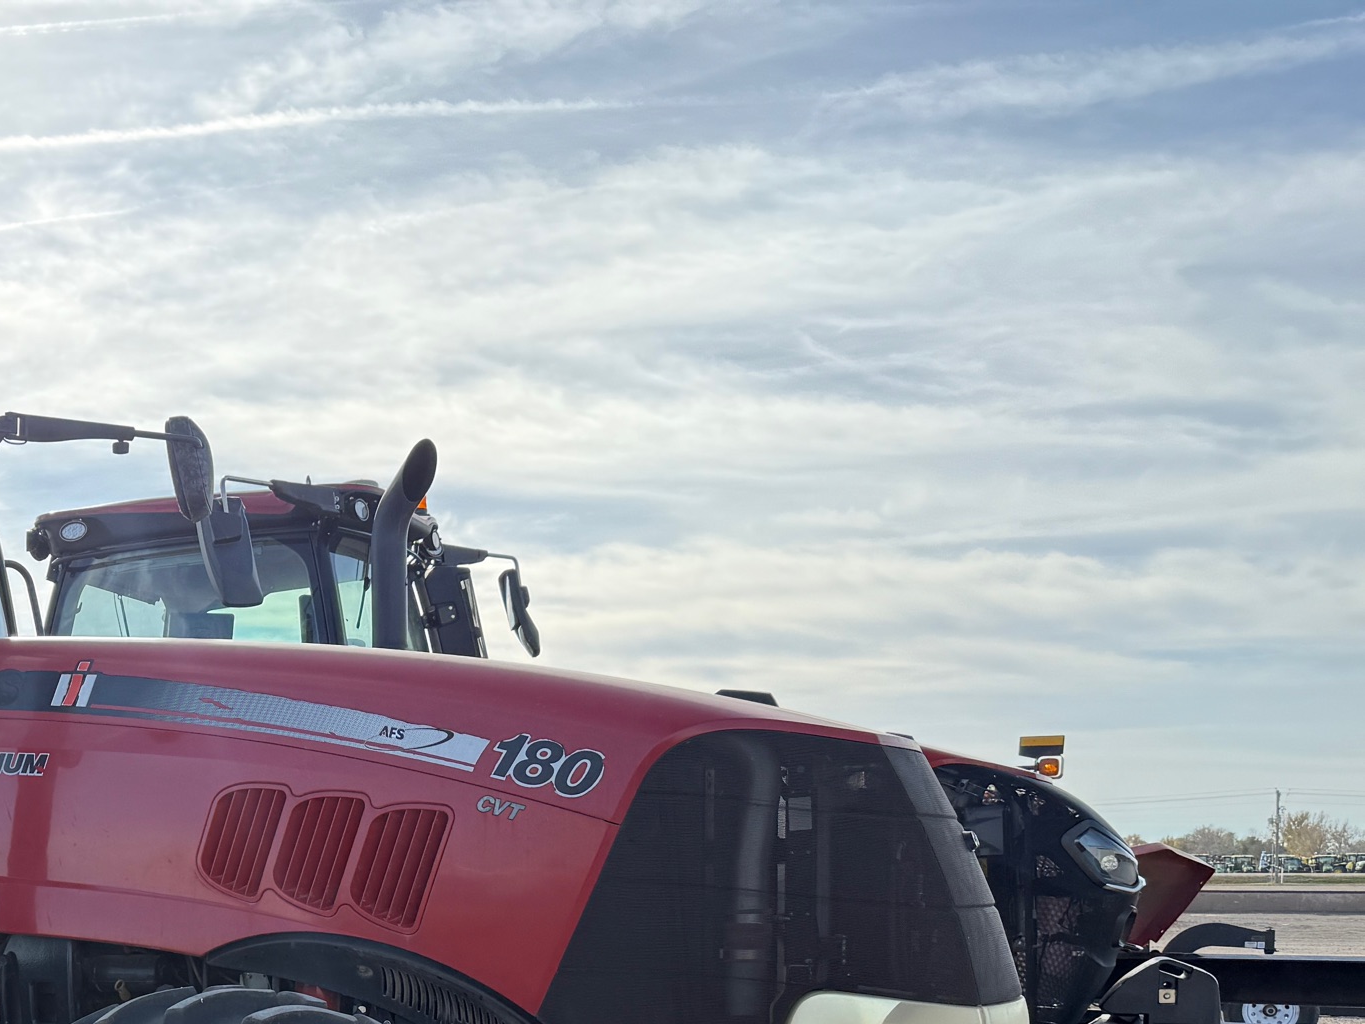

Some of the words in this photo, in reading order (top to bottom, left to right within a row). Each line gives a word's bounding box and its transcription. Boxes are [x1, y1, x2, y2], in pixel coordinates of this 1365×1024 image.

[379, 725, 405, 740] AFS
[489, 733, 606, 798] 180
[476, 795, 525, 821] CVT
